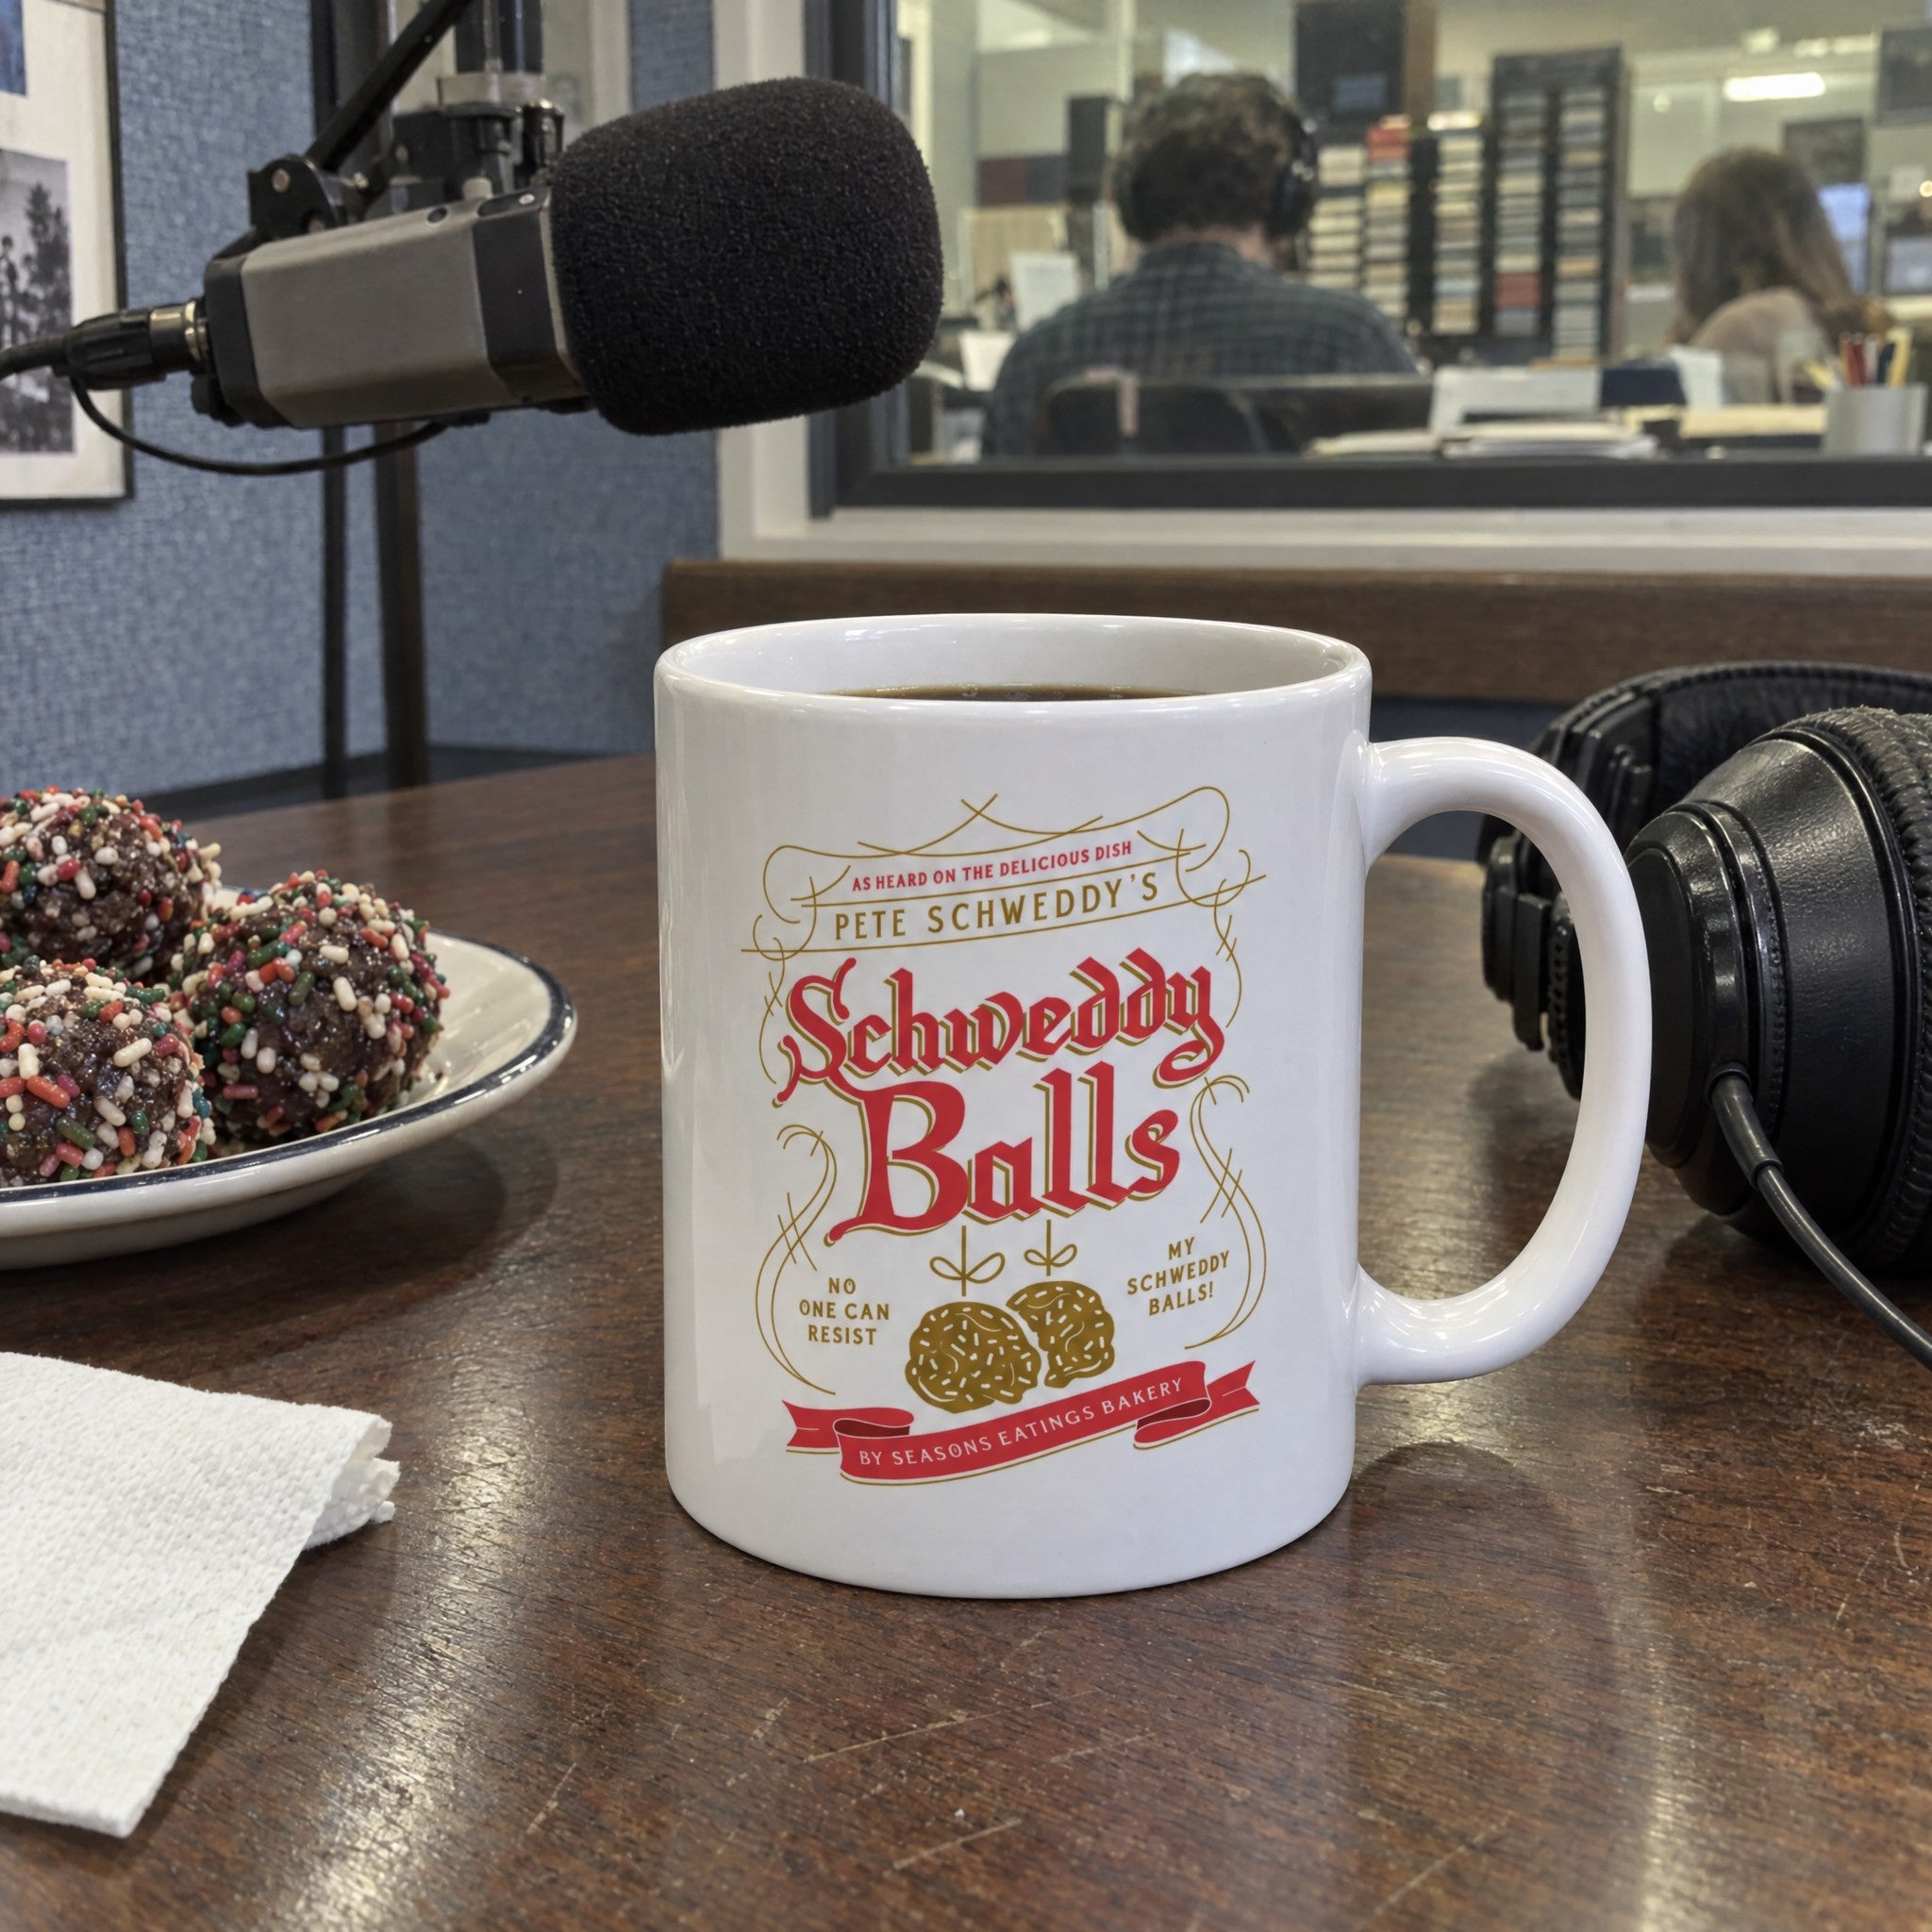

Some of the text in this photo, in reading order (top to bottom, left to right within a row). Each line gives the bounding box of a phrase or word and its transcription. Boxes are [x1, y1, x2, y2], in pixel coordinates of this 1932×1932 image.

[852, 841, 1132, 891] AS HEARD ON THE DELICIOUS DISH
[835, 872, 1158, 941] PETE SCHWEDDY'S
[772, 947, 1225, 1108] Schweddy
[824, 1060, 1181, 1246] Balls
[1168, 1237, 1195, 1261] MY
[828, 1276, 857, 1294] NO
[1126, 1250, 1230, 1296] SCHWEDDY
[799, 1299, 890, 1321] ONE CAN
[1148, 1282, 1214, 1318] BALLS!
[808, 1324, 877, 1346] RESIST
[859, 1377, 1183, 1467] BY SEASONS EATINGS BAKERY
